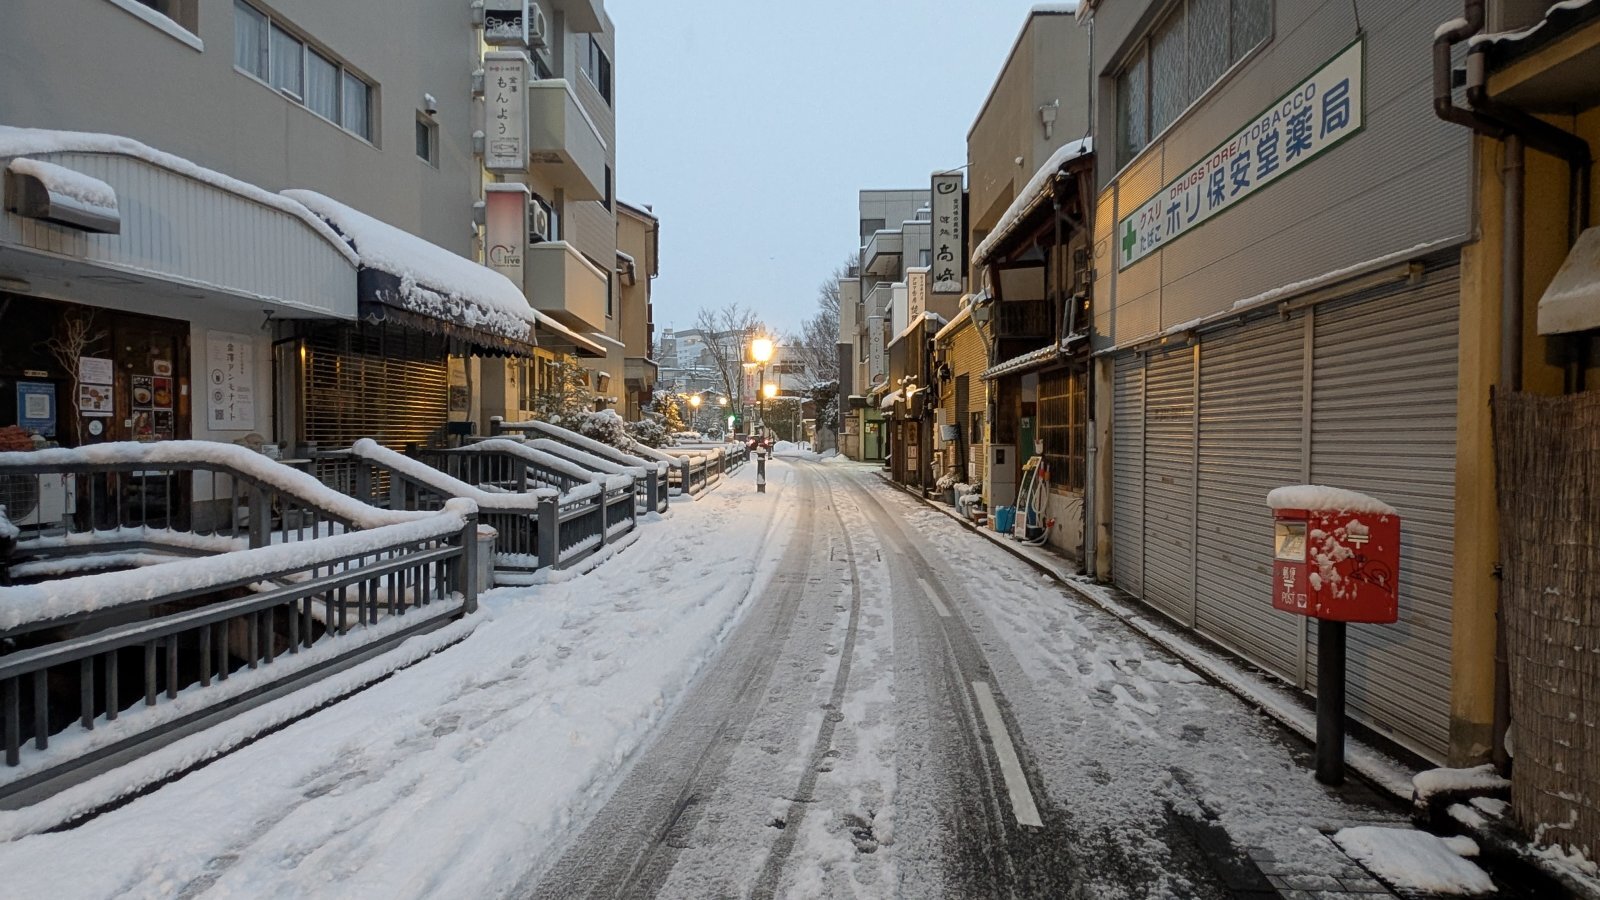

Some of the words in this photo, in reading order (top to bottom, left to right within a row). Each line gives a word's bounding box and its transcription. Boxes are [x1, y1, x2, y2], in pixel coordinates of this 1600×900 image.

[496, 76, 508, 135] もんよう
[1166, 78, 1350, 236] ホリ保安堂薬局
[1140, 199, 1162, 230] クスリ
[1139, 225, 1161, 253] たばこ
[1282, 566, 1296, 581] 郵便
[1281, 591, 1296, 605] POST
